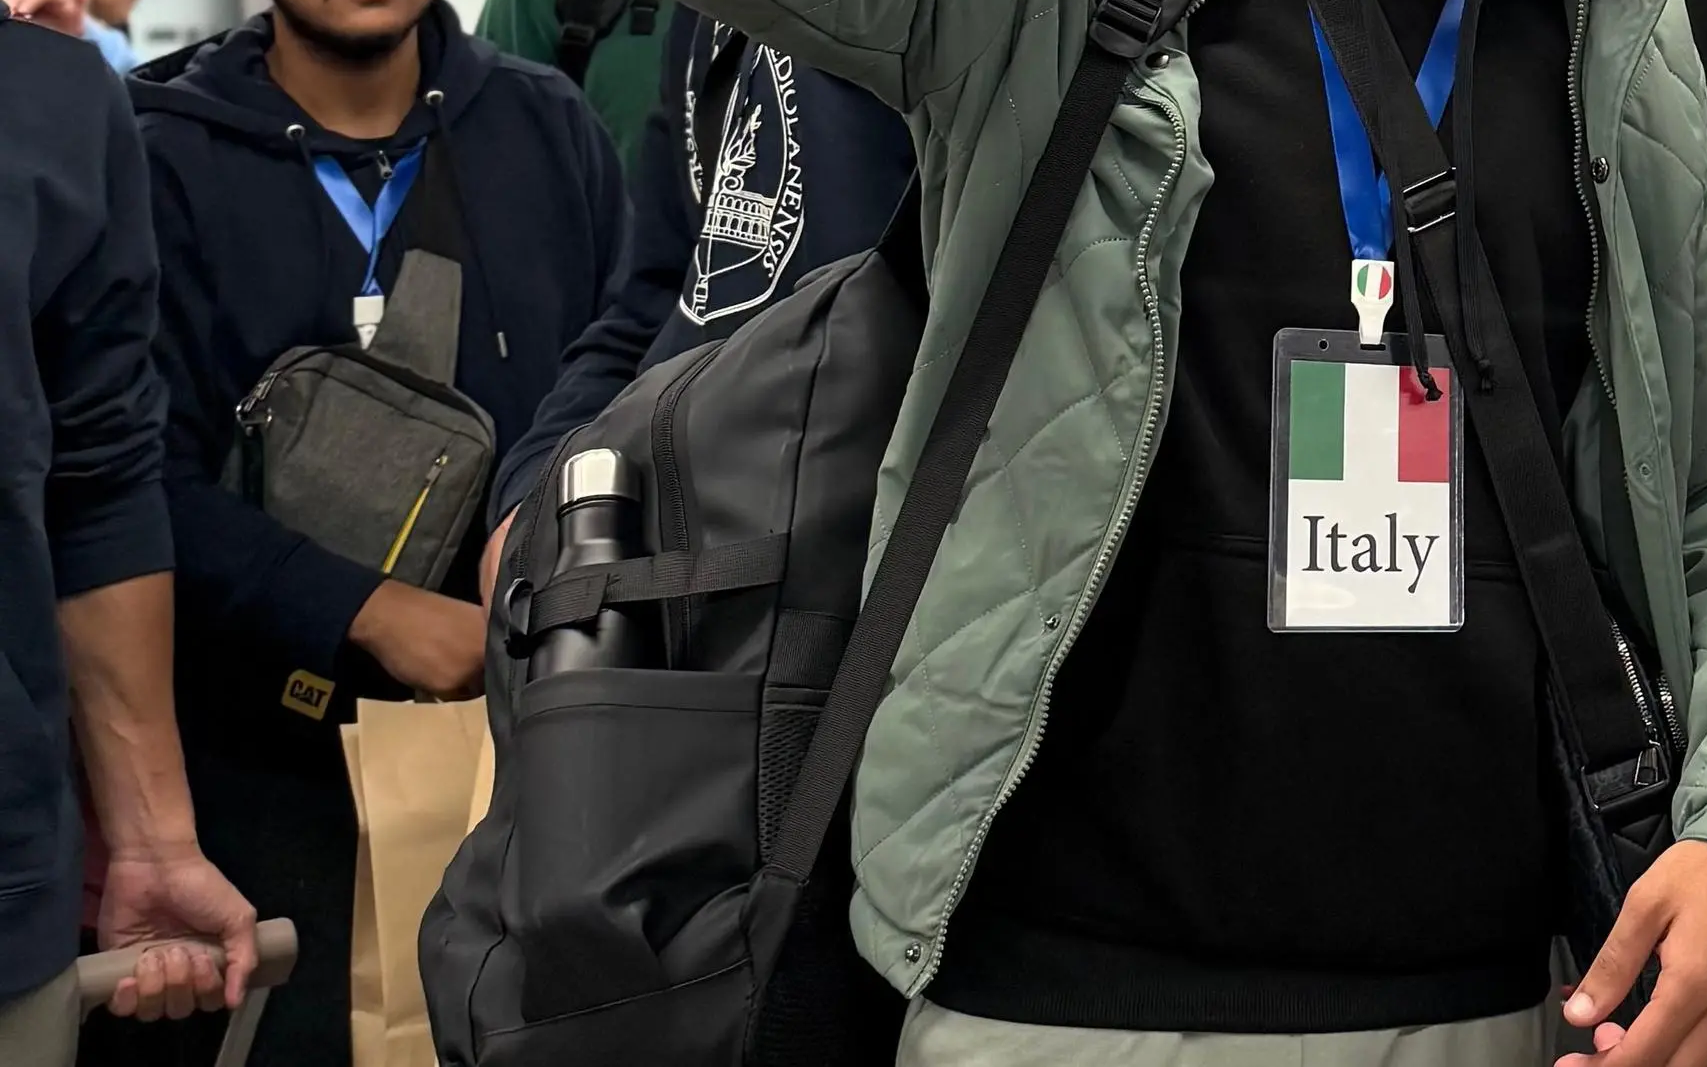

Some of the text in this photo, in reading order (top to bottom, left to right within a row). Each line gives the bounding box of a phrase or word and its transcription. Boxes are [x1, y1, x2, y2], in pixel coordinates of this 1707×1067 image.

[762, 48, 804, 278] DIOLANENSIS
[1302, 512, 1440, 594] Italy
[290, 679, 328, 708] CAT
